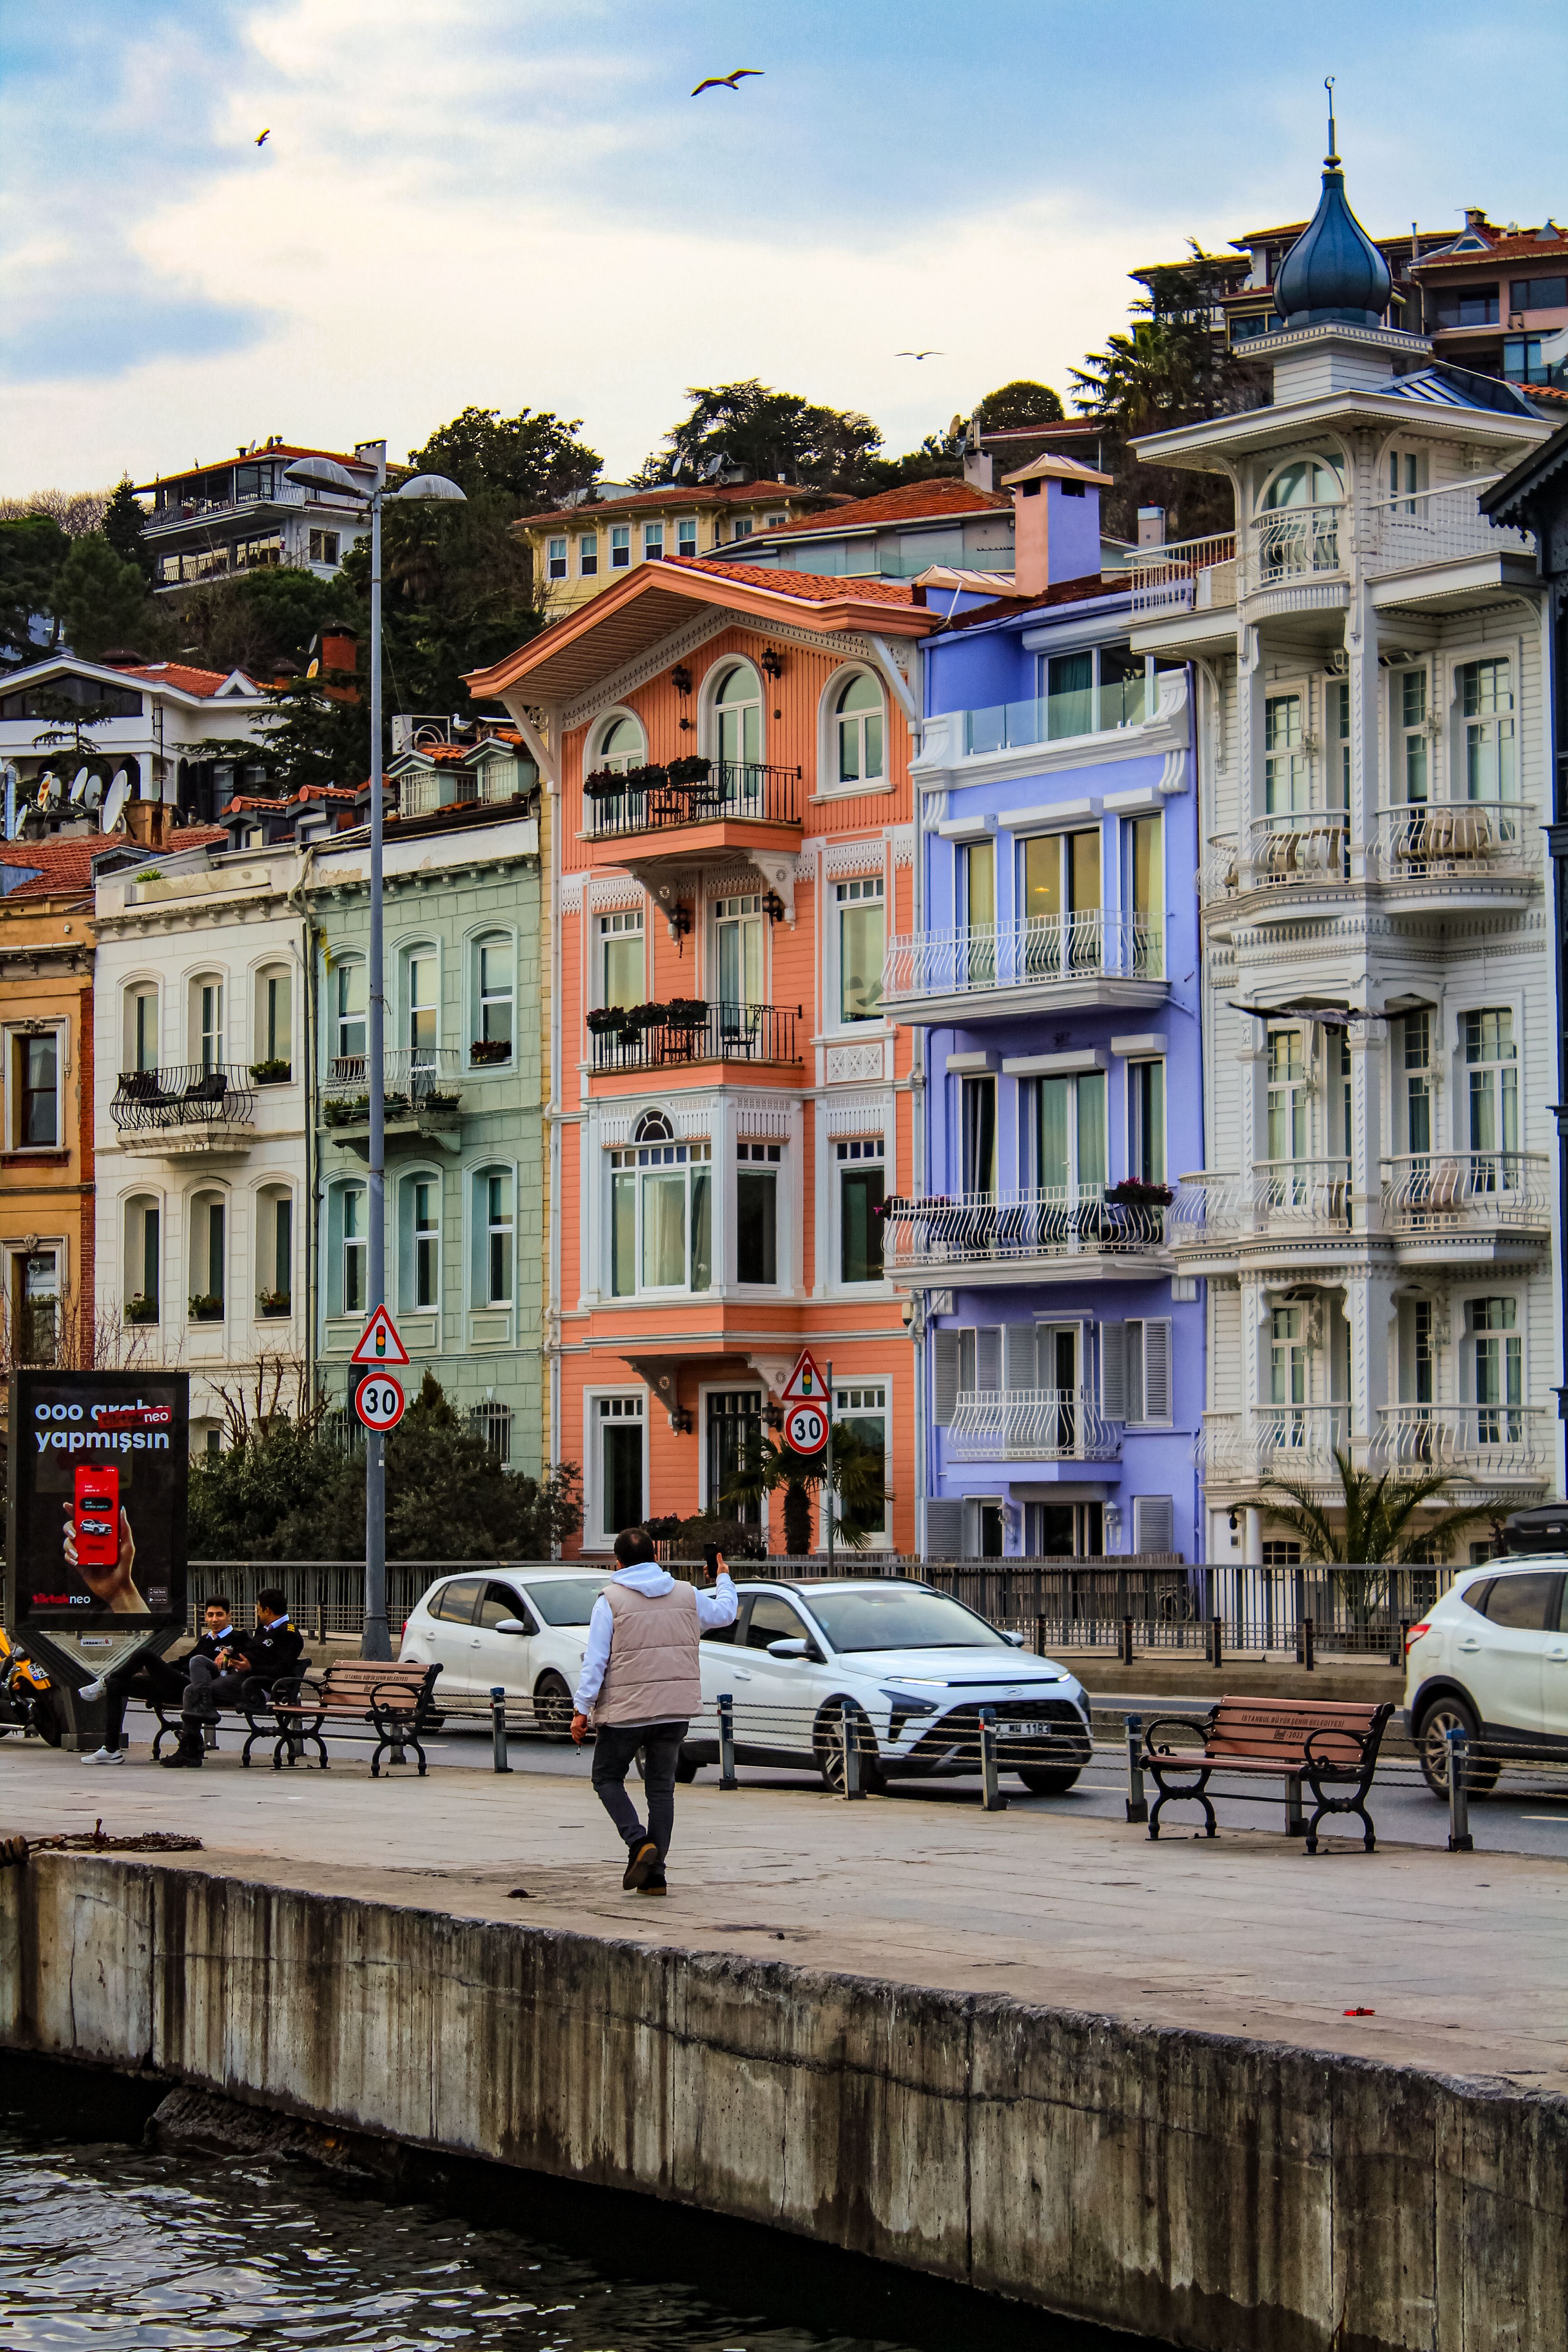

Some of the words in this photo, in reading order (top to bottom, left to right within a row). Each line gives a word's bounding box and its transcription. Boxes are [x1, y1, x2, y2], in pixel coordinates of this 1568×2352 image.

[35, 1404, 83, 1420] ooo
[91, 1399, 169, 1421] arb
[365, 1388, 396, 1415] 30
[794, 1417, 820, 1441] 30
[35, 1431, 169, 1453] yapmışsın
[1241, 1714, 1269, 1723] İSTANBUL
[1271, 1716, 1308, 1725] BÜYÜKŞEHİR
[1309, 1719, 1344, 1727] BELEDİYESİ
